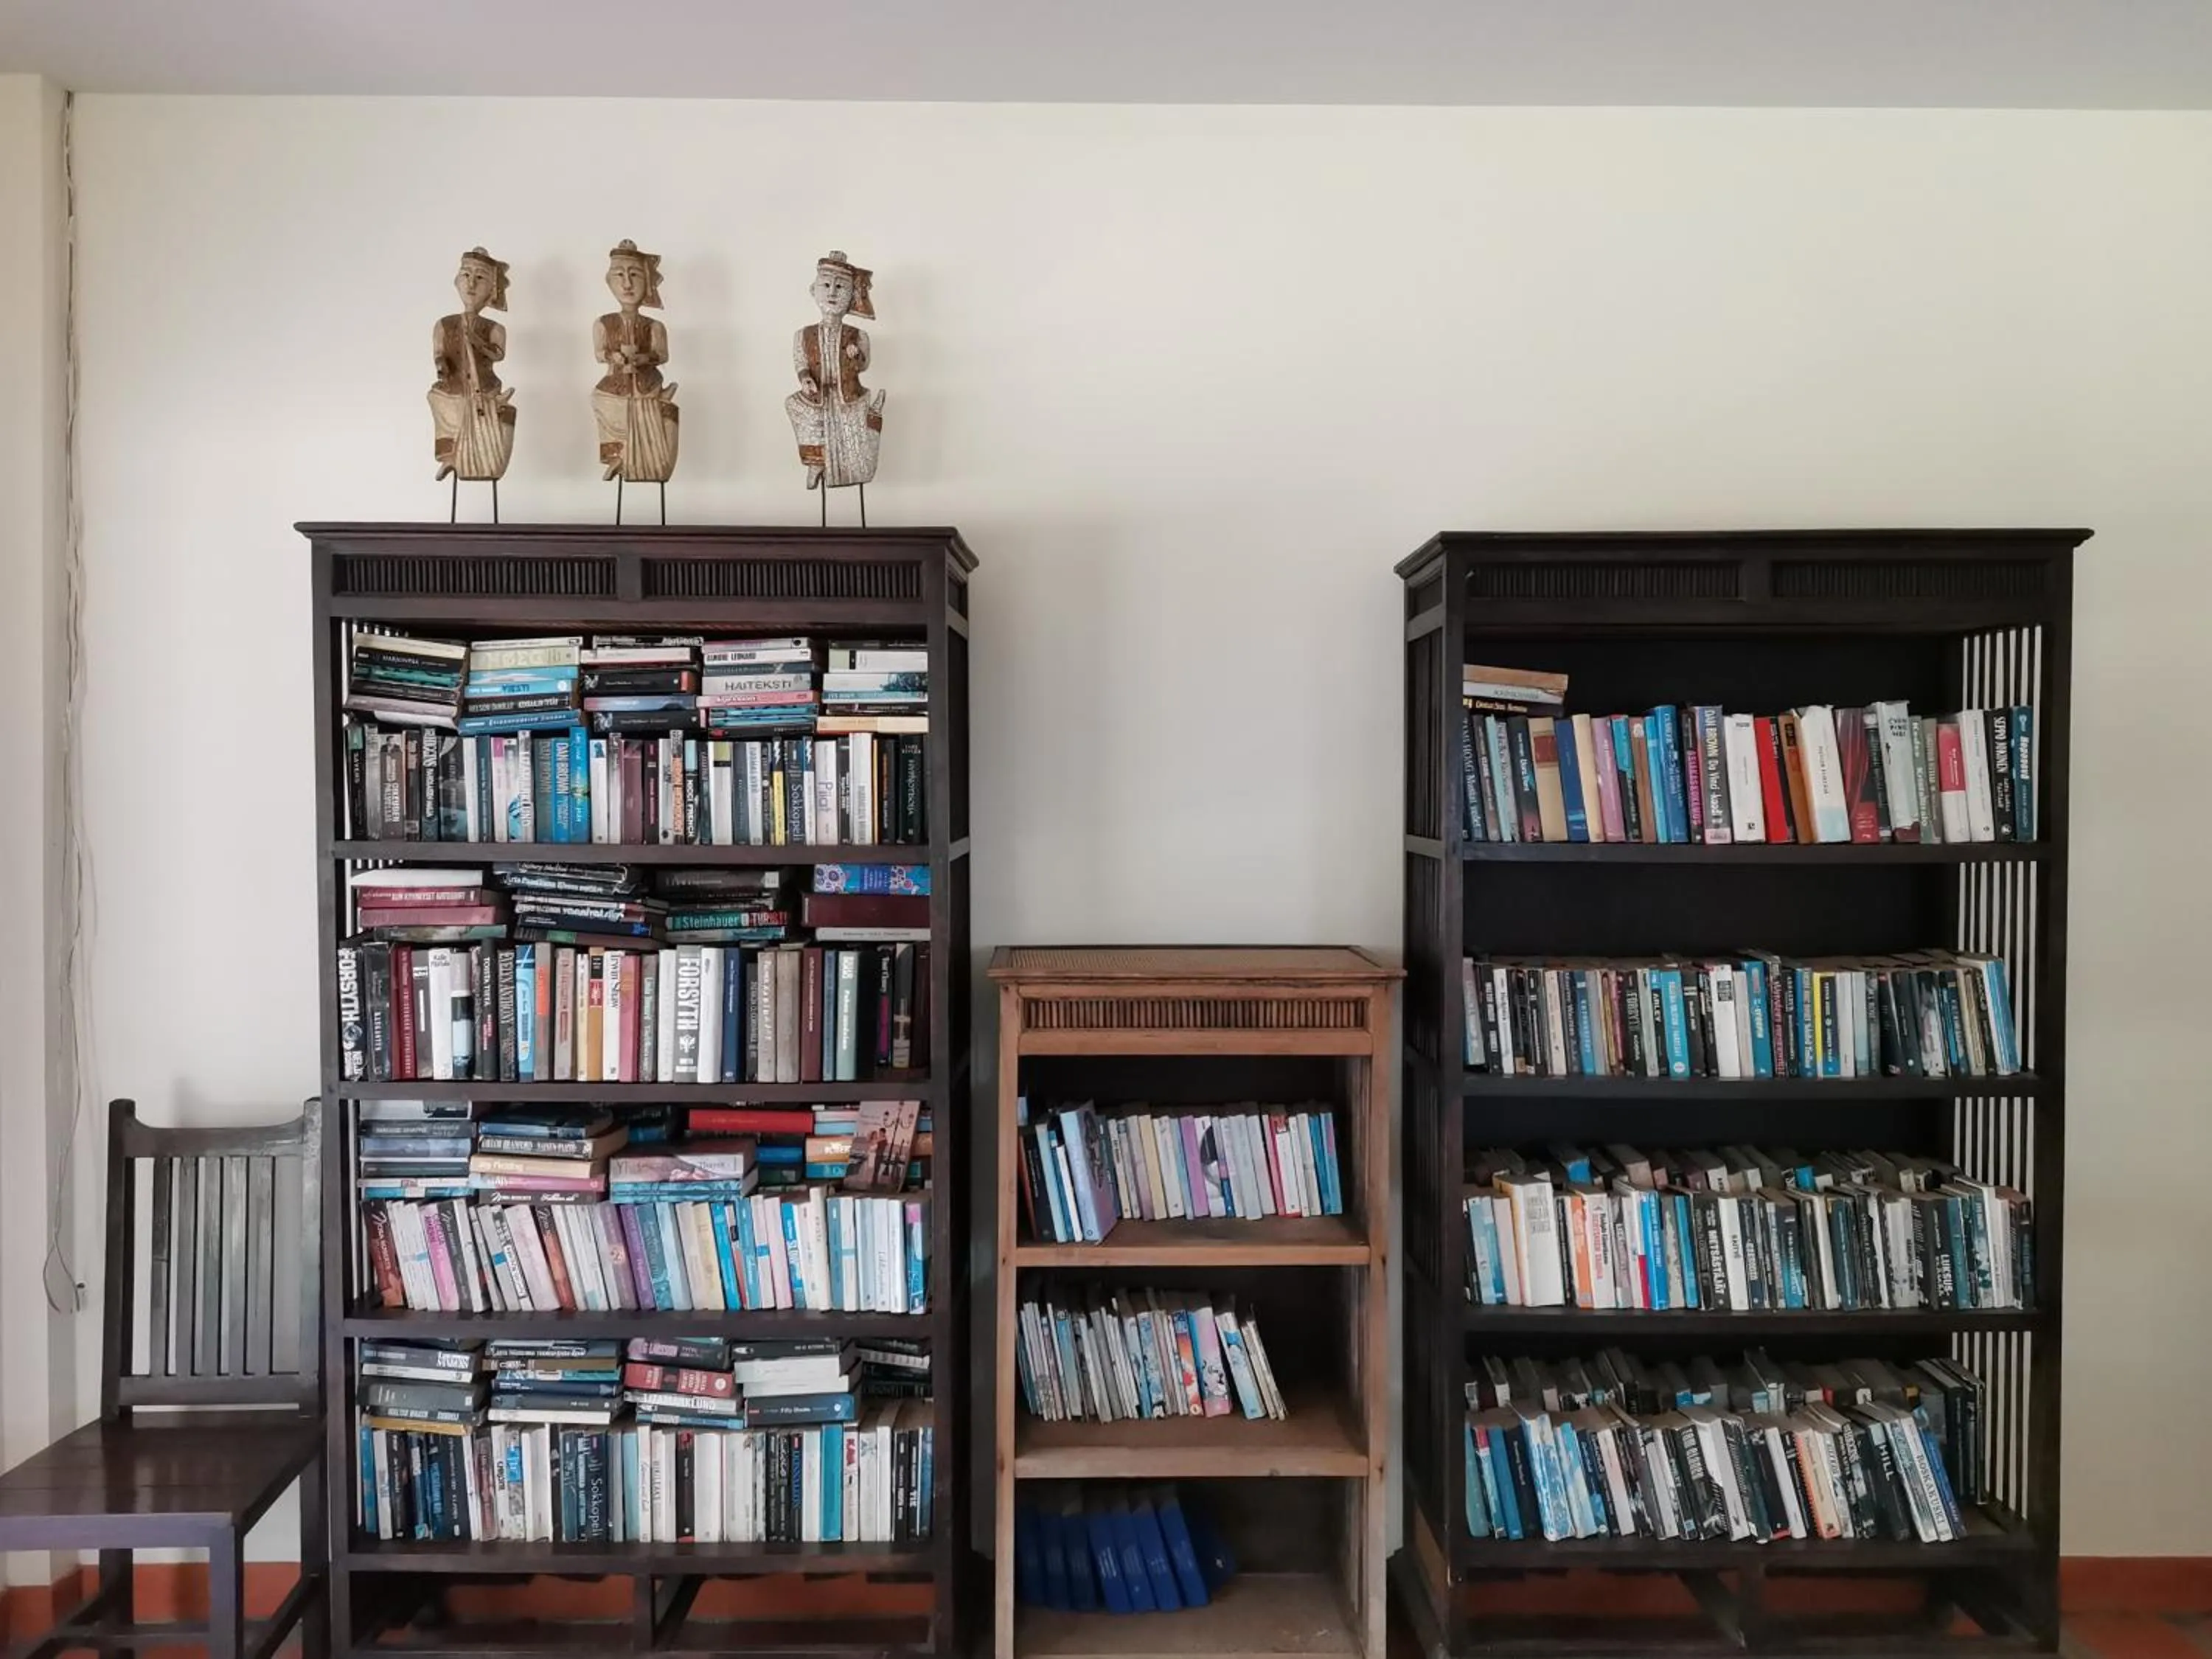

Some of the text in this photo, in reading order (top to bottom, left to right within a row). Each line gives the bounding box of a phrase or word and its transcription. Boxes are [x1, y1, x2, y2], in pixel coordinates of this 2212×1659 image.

[555, 742, 569, 794] DAN BROWN
[1463, 745, 1475, 772] HOAG
[1704, 710, 1722, 816] DAN BROWN Da Vinci -koodi
[1993, 716, 2008, 773] SEPPO JOKINEN
[687, 804, 695, 838] FRENCH
[791, 784, 804, 841] Sokkopeli
[683, 914, 740, 929] Steinhauer
[338, 950, 360, 1021] FORSYTH
[500, 952, 515, 1025] EVELYN ANTHONY
[611, 954, 621, 980] Irwin
[677, 958, 700, 1031] FORSYTH
[372, 1211, 392, 1270] NORA ROBERTS
[1708, 1229, 1727, 1296] METSÄSTÄJÄT
[1878, 1444, 1895, 1481] HILL
[588, 1478, 603, 1537] Sokkopeli
